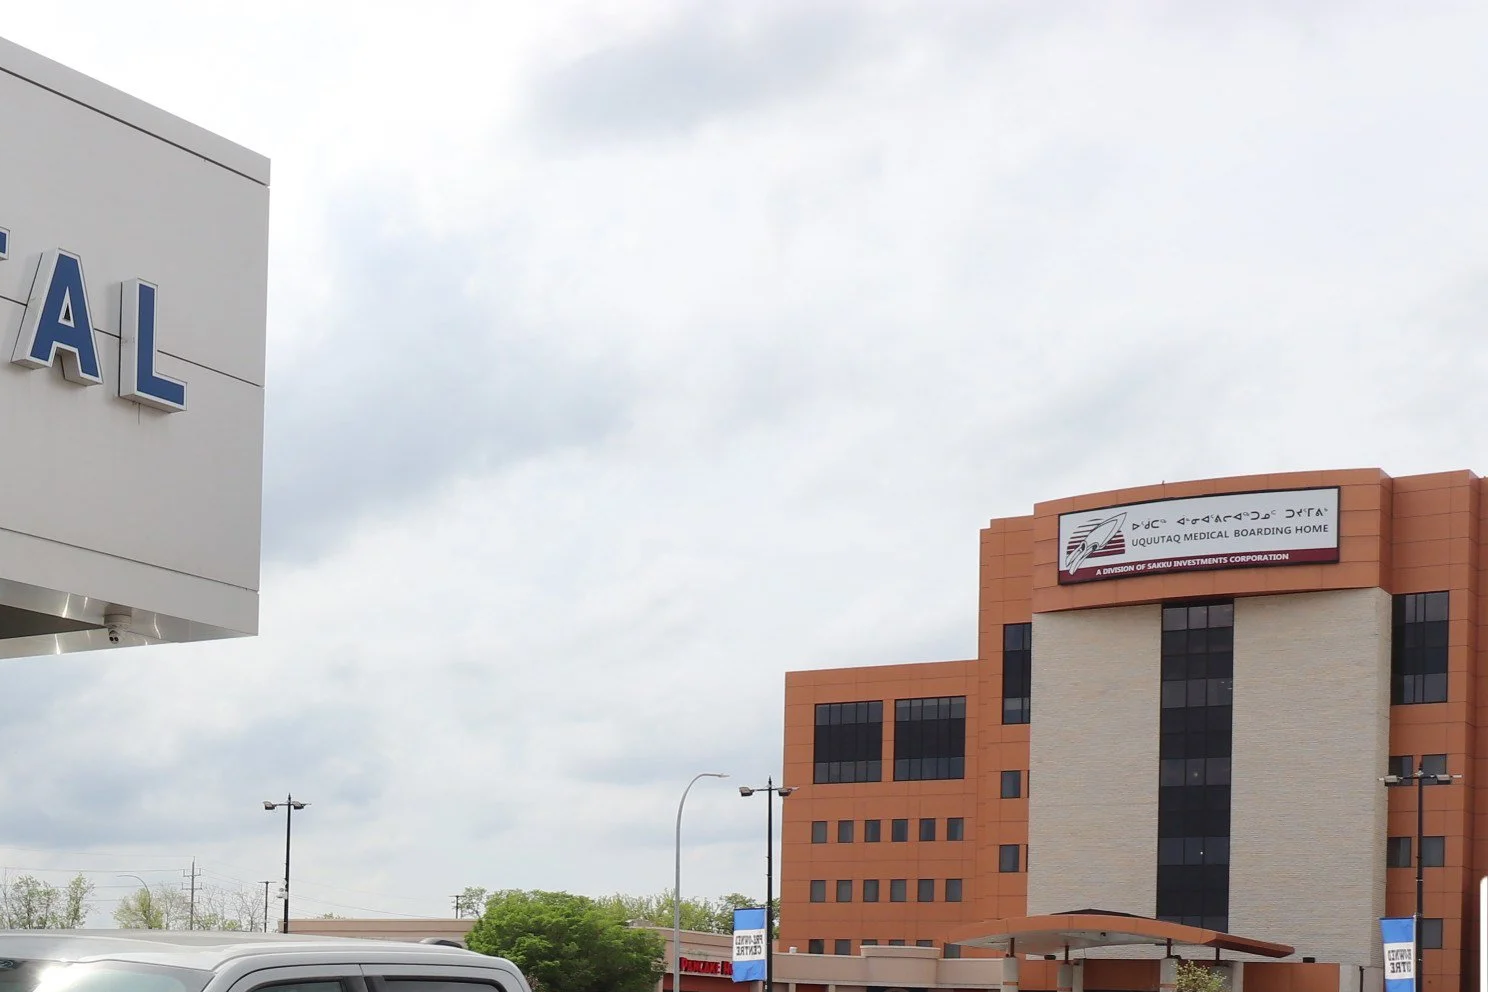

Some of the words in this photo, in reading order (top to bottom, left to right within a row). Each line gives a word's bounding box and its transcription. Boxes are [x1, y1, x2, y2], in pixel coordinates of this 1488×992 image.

[1132, 534, 1181, 547] UQUUTAQ
[1184, 530, 1230, 542] MEDICAL
[1234, 526, 1292, 538] BOARDING
[1295, 524, 1329, 534] HOME
[1103, 564, 1134, 575] DIVISION
[1136, 563, 1146, 571] OF
[1147, 561, 1172, 570] SAKKU
[1173, 556, 1228, 567] INVESTMENTS
[1229, 553, 1290, 563] CORPORATION
